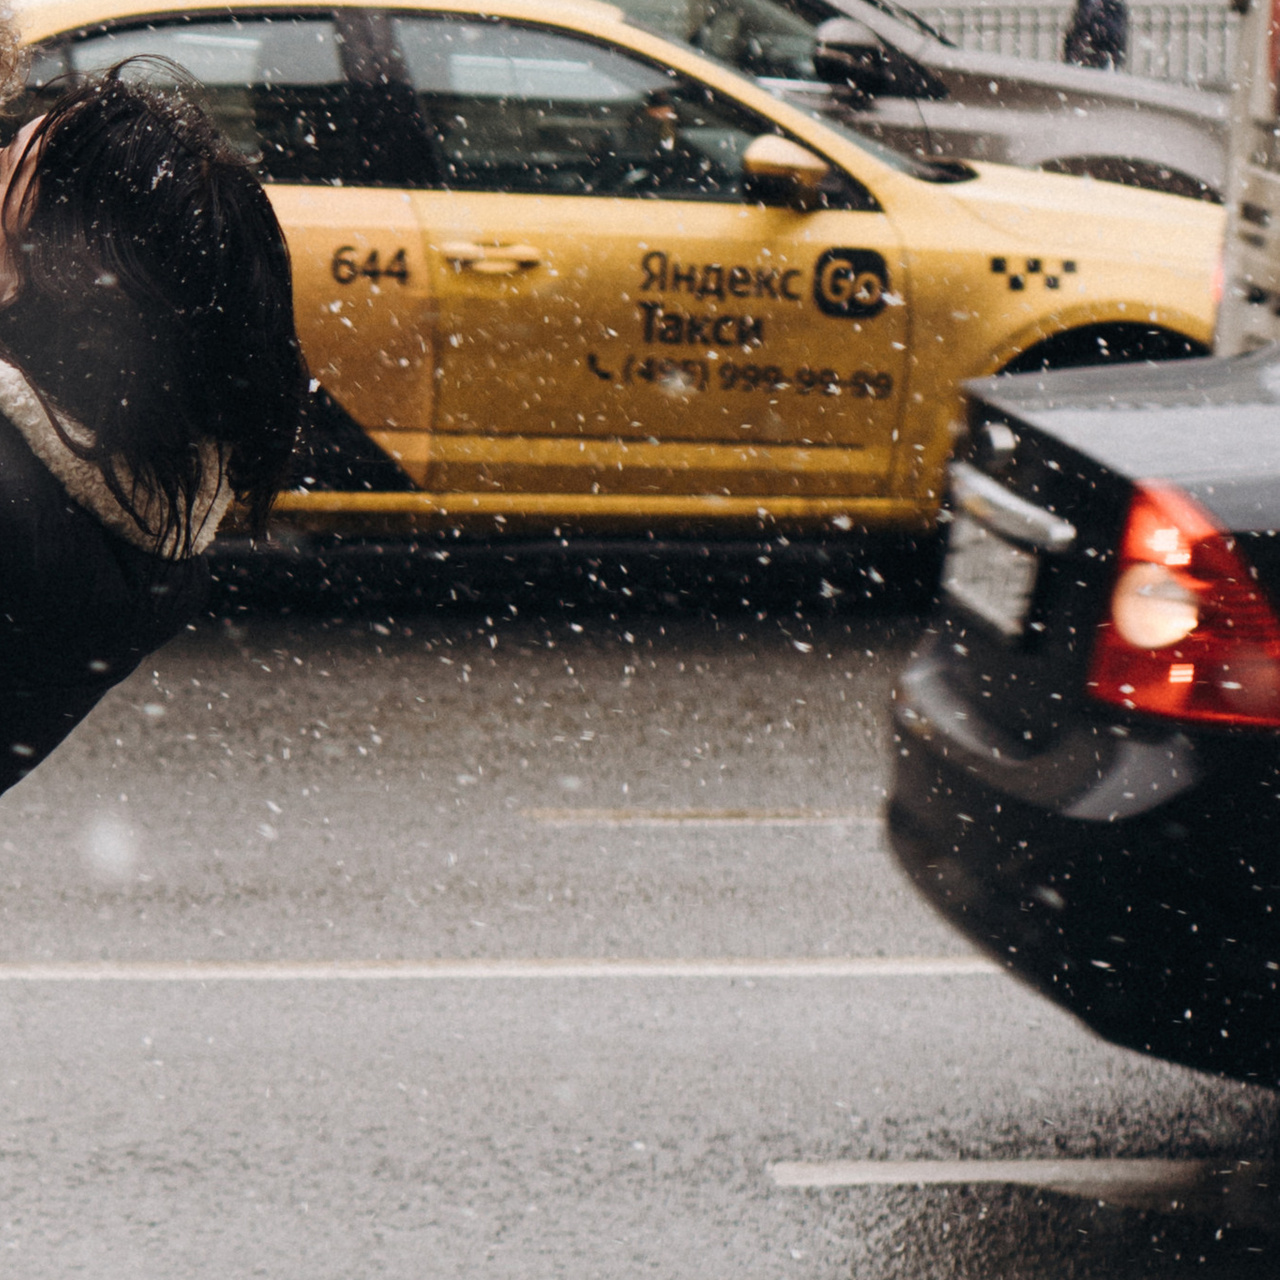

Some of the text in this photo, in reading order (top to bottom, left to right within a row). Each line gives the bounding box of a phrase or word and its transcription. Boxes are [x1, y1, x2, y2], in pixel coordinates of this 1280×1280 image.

[331, 247, 408, 285] 644
[639, 251, 883, 305] Яндекс Go
[638, 301, 763, 347] Такси
